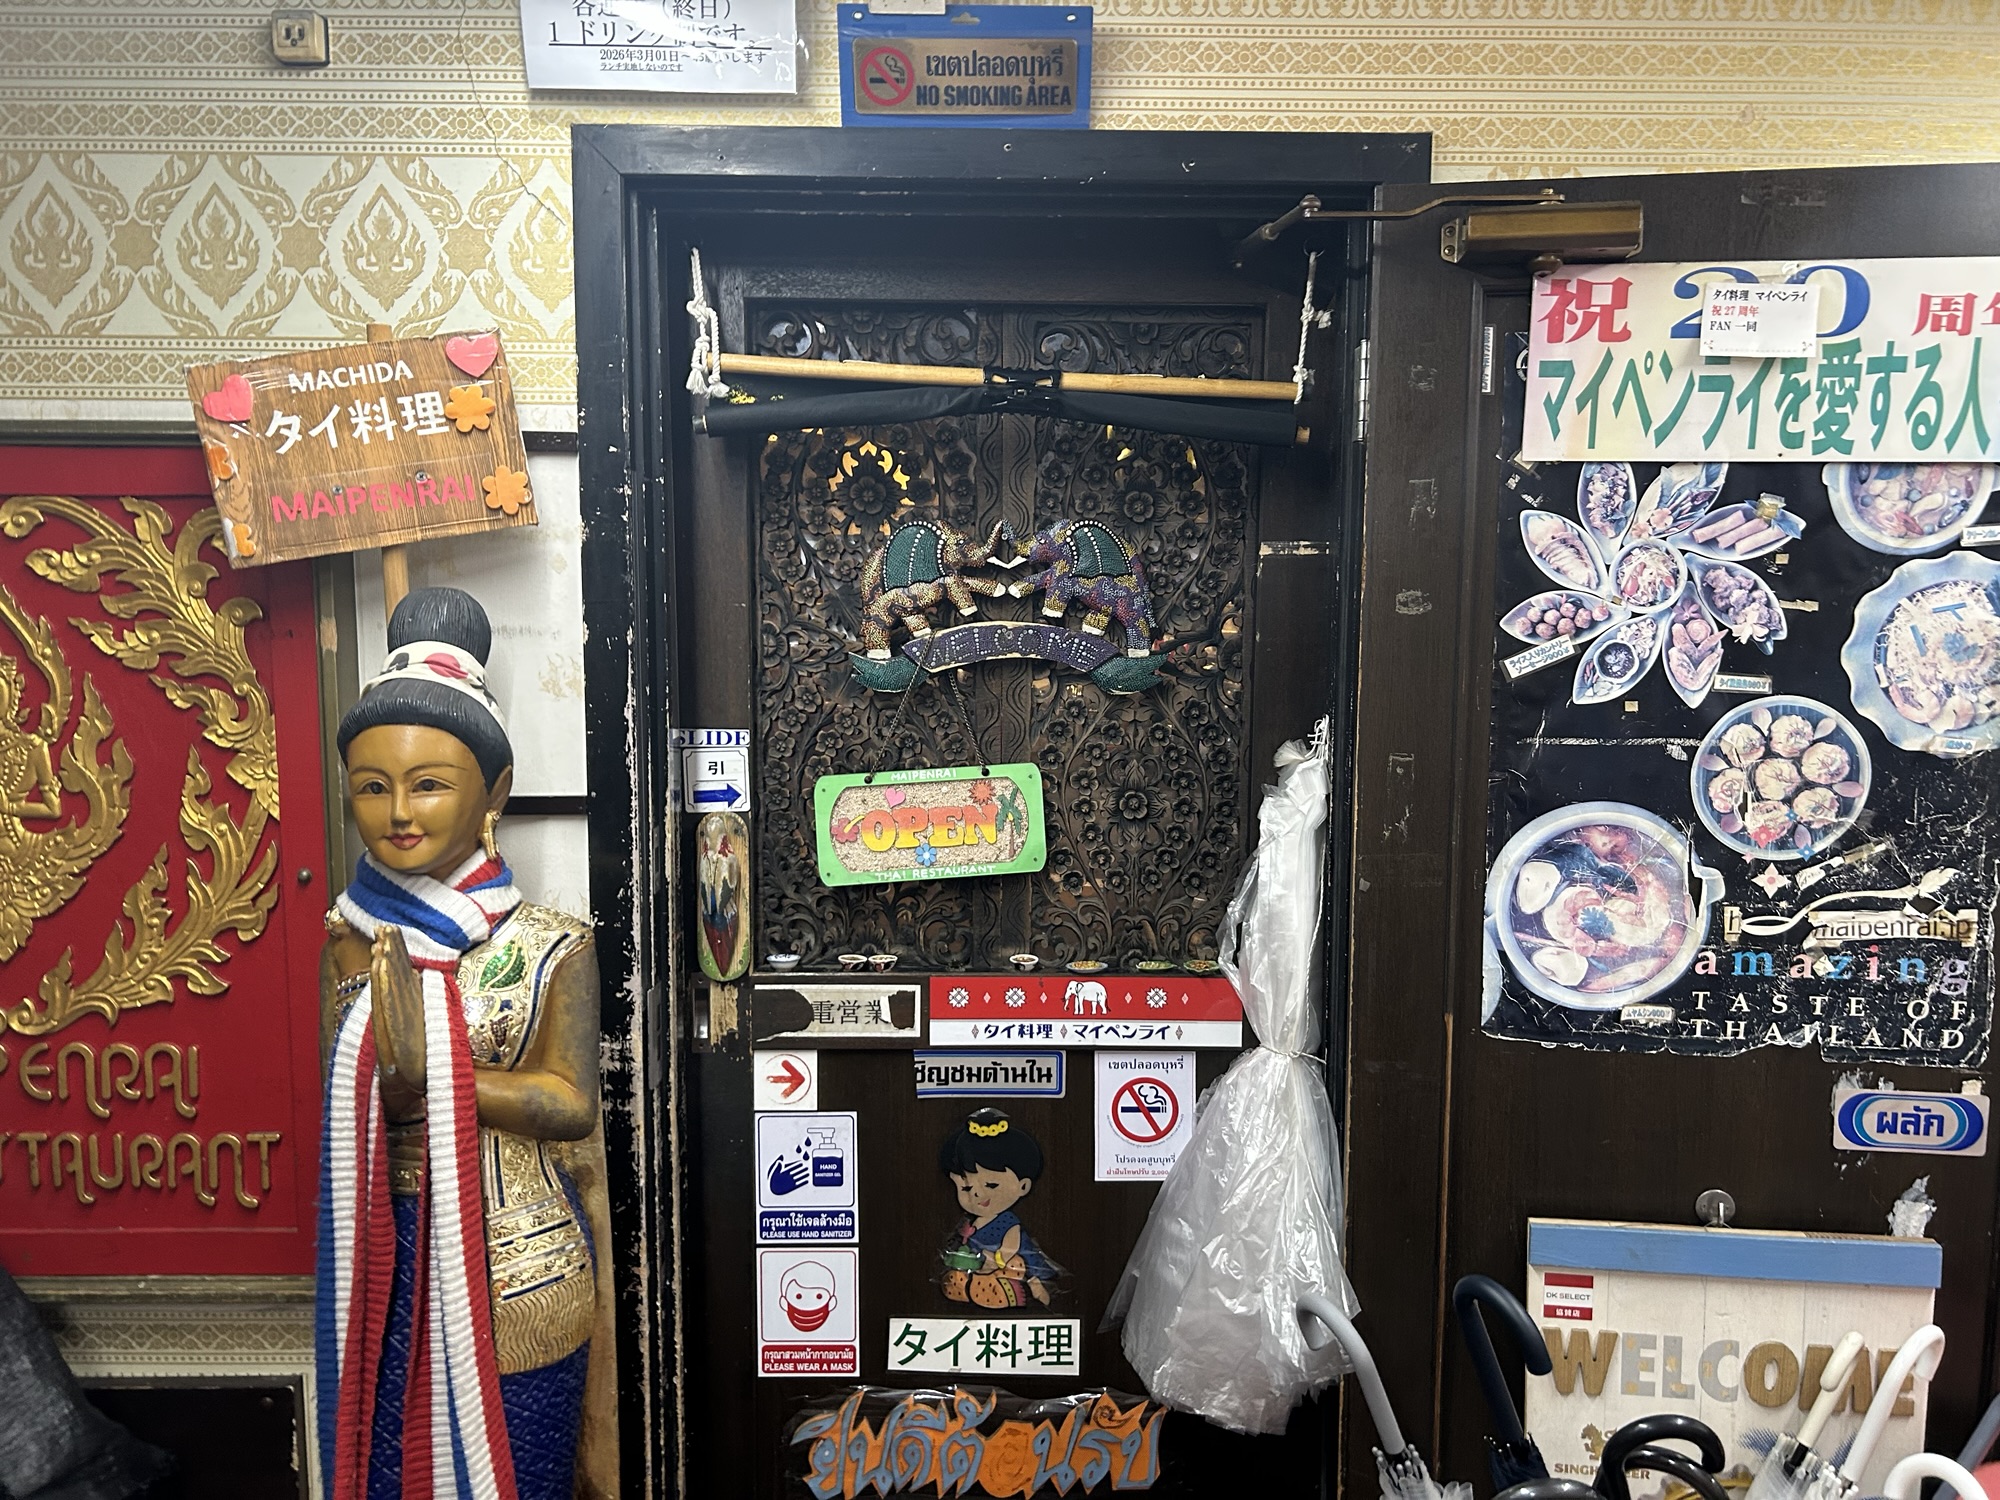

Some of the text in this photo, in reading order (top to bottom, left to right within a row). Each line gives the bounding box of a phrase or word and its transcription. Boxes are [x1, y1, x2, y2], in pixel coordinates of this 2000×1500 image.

[550, 21, 559, 43] 1
[926, 45, 1064, 84] เขตปลอดบุหรี่
[916, 85, 1072, 107] NO SMOKING AREA
[1537, 277, 1632, 344] 祝
[1671, 265, 1870, 339] 20
[1713, 289, 1808, 302] タイ料理 マイペンライ
[1712, 305, 1759, 316] 祝 27 周年
[1710, 321, 1757, 332] FAN 一同
[290, 360, 414, 394] MACHIDA
[265, 391, 450, 455] タイ料理
[272, 474, 476, 523] MAIPENRAI
[912, 627, 1098, 669] WELCOME
[708, 761, 724, 775] 引
[891, 768, 957, 781] MAIPENRAI
[861, 804, 998, 852] OPEN
[875, 864, 996, 882] THAI RESTAURANT
[1694, 945, 1968, 995] amazing
[1692, 991, 1967, 1021] TASTE OF
[984, 1023, 1170, 1040] タイ料理 マイペンライ
[1691, 1019, 1964, 1049] THAILAND
[1108, 1055, 1184, 1074] เขตปลอดบุหรี่
[0, 1042, 198, 1118] ENRAI
[1876, 1106, 1944, 1137] ผลัก
[762, 1212, 852, 1230] กรุณาใช้เจลล้างมือ
[764, 1347, 853, 1363] กรุณาสวมหน้ากากอนามัย
[893, 1322, 1074, 1368] タイ料理
[764, 1363, 794, 1371] PLEASE
[797, 1363, 820, 1371] WEAR
[830, 1363, 853, 1371] MASK
